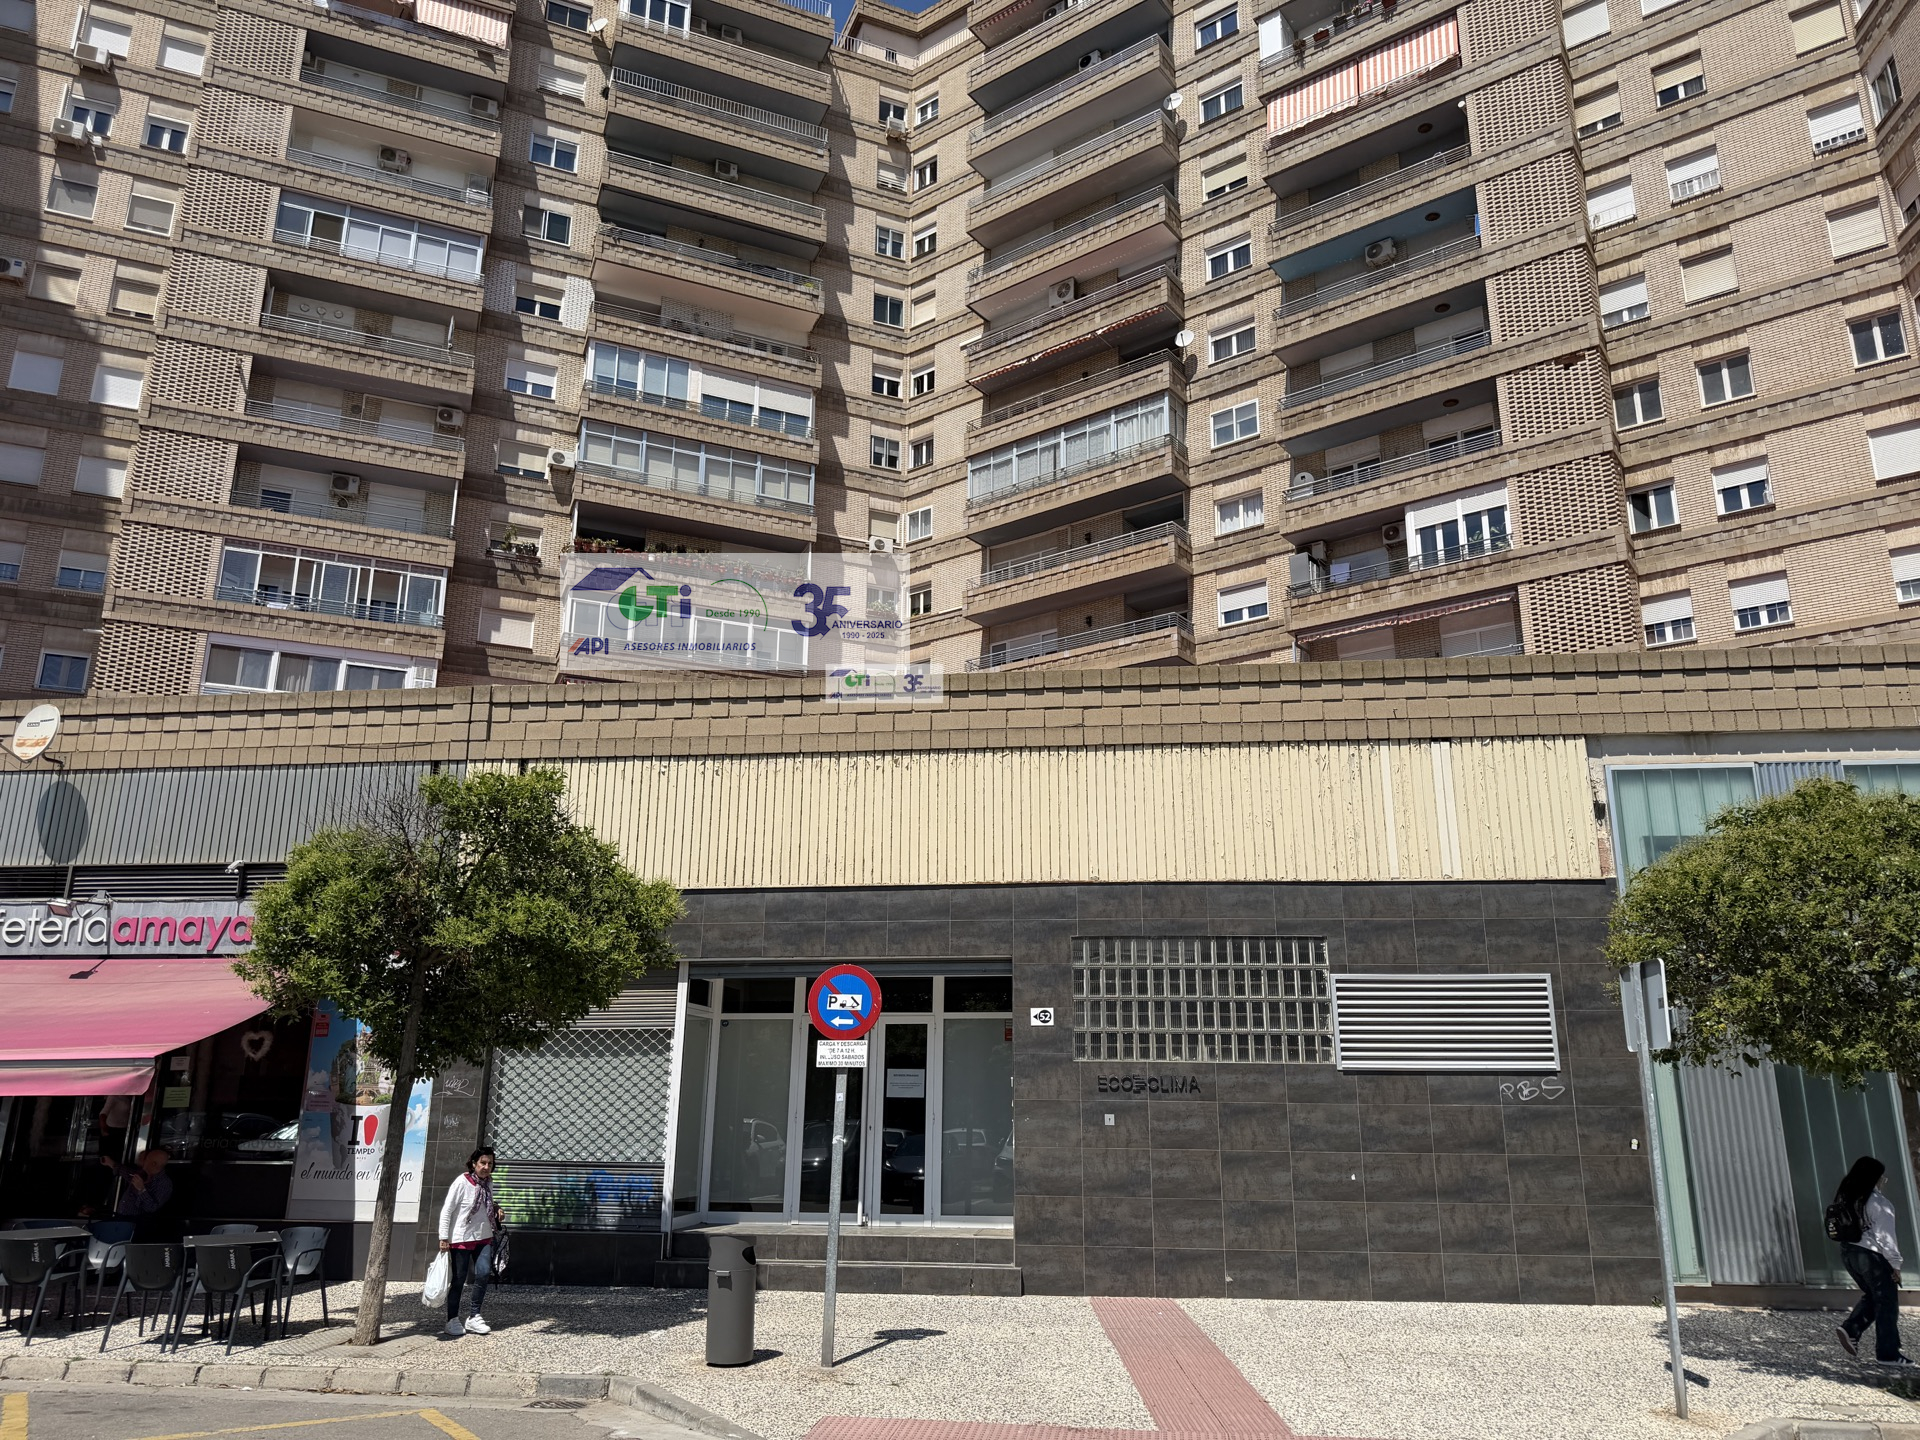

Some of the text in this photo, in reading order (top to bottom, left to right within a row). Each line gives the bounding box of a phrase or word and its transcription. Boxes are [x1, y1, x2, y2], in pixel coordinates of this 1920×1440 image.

[113, 916, 256, 950] amaya
[828, 995, 838, 1008] P
[1039, 1012, 1051, 1021] 52
[348, 1116, 363, 1145] I
[347, 1147, 375, 1155] TEMPLO
[300, 1162, 315, 1180] el
[313, 1163, 353, 1180] mundo
[356, 1170, 371, 1180] en
